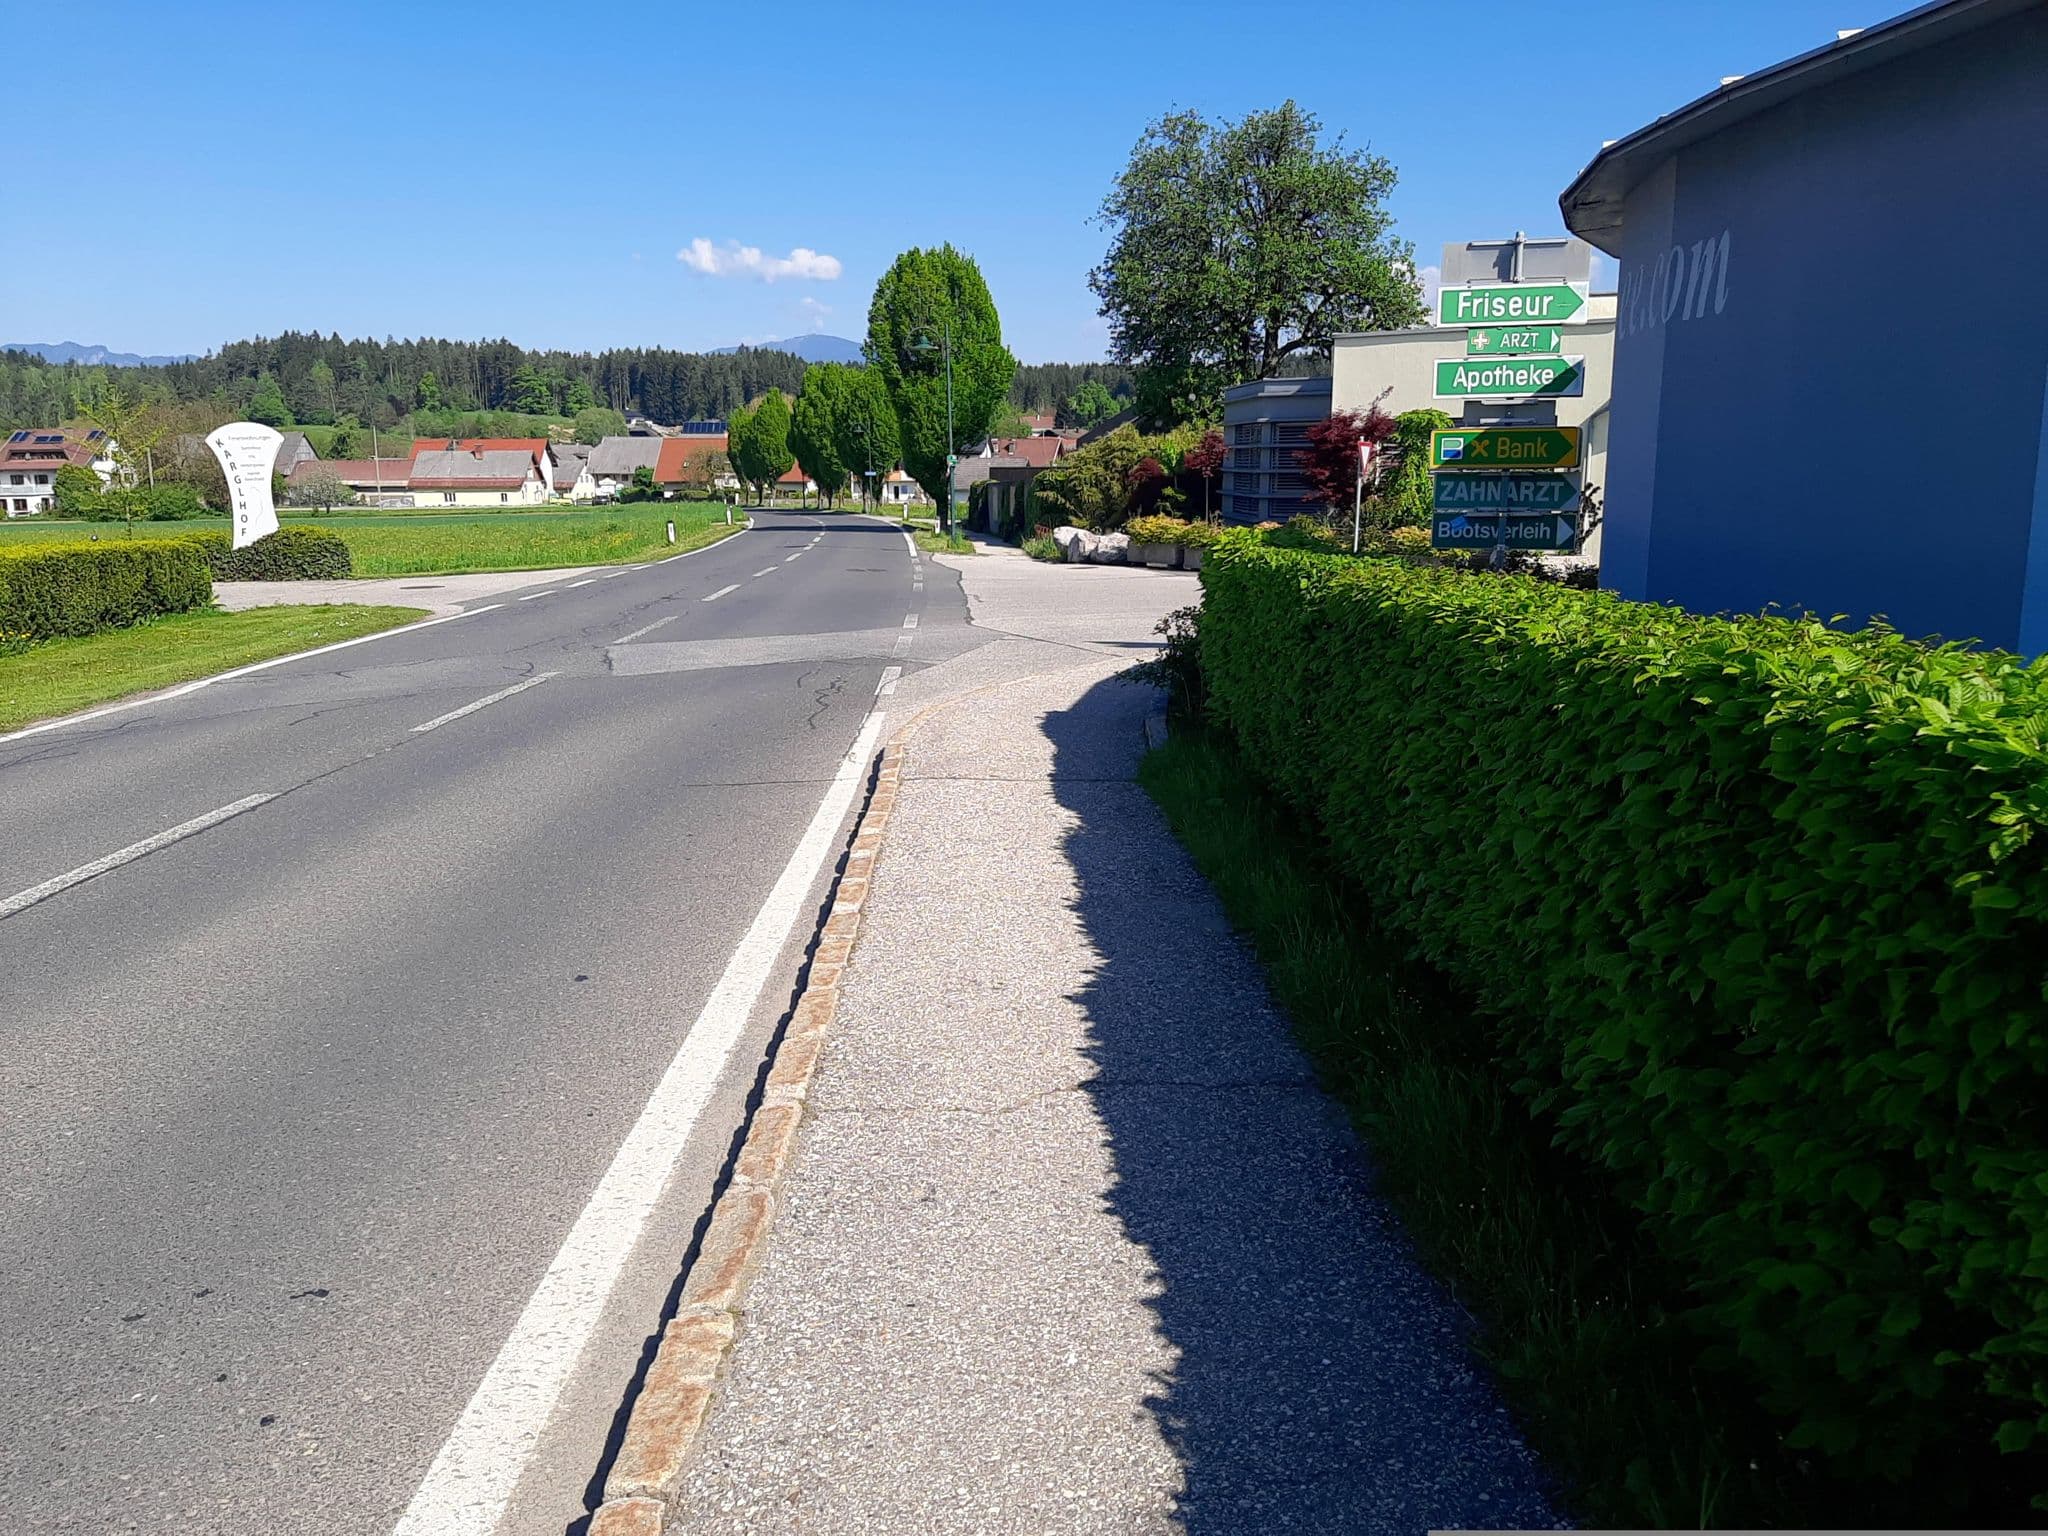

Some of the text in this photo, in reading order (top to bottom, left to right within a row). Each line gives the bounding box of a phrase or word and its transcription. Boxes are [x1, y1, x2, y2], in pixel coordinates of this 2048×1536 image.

[1457, 291, 1554, 318] Friseur
[1500, 332, 1540, 348] ARZT
[1453, 364, 1555, 392] Apotheke
[1497, 437, 1549, 458] Bank
[1439, 481, 1565, 502] ZAHNARZT
